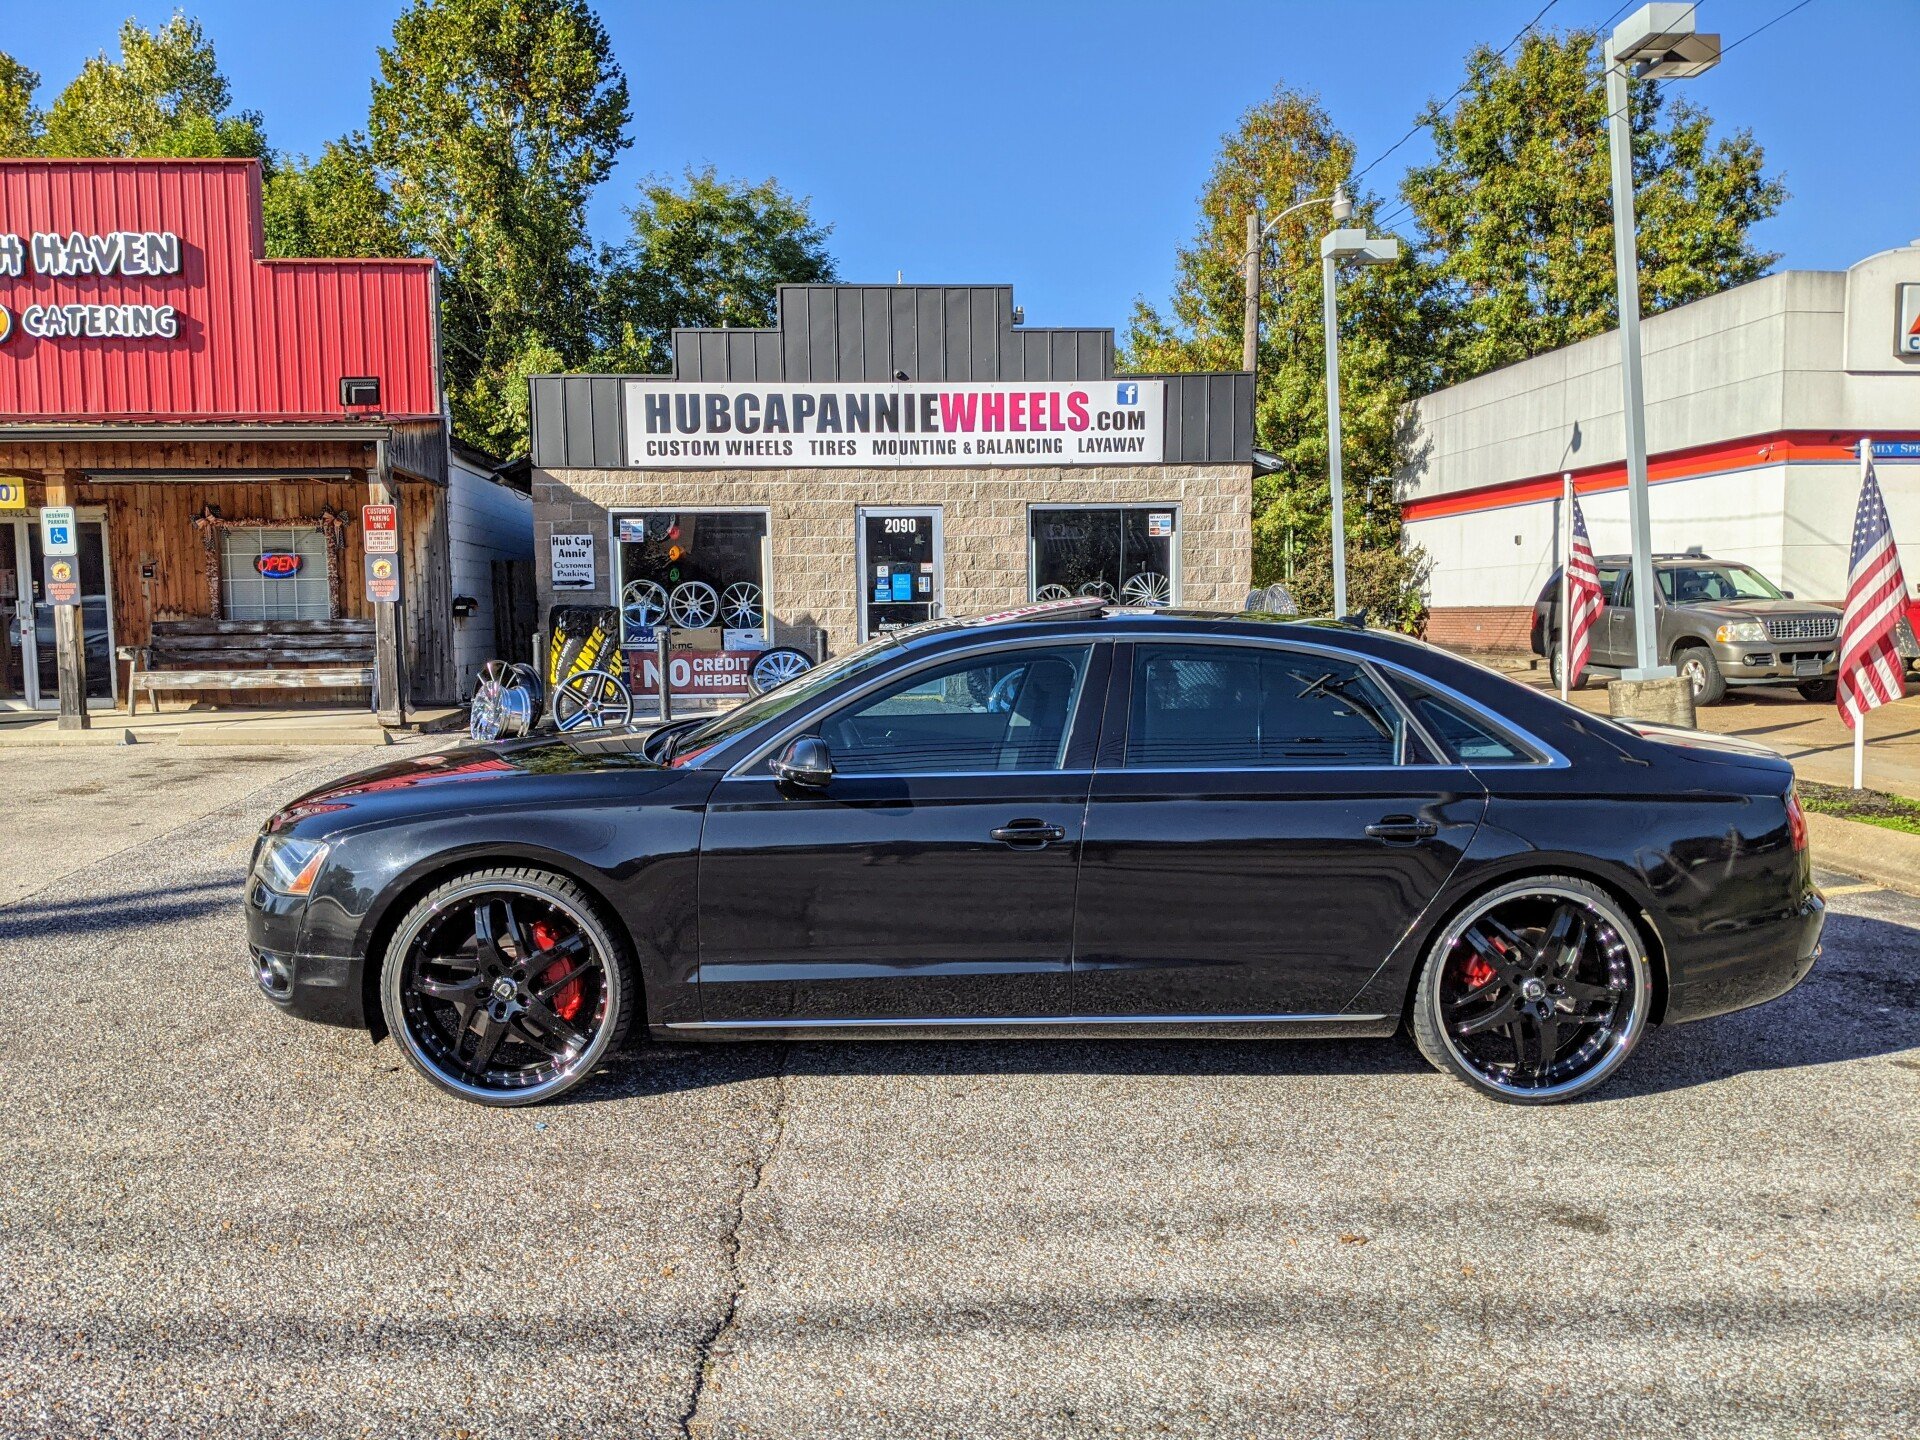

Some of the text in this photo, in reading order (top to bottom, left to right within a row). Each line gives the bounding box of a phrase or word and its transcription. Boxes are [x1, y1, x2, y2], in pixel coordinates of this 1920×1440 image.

[31, 232, 179, 276] HAVEN
[646, 436, 1145, 456] CUSTOM WHEELS TIRES MOUNTING & BALANCING LAYAWAY
[1871, 443, 1895, 454] AILY
[885, 518, 916, 533] 2090
[552, 536, 592, 548] Hub Cap
[558, 548, 587, 558] Annie
[257, 555, 300, 571] OPEN
[693, 657, 749, 672] CREDIT
[643, 658, 691, 688] NO
